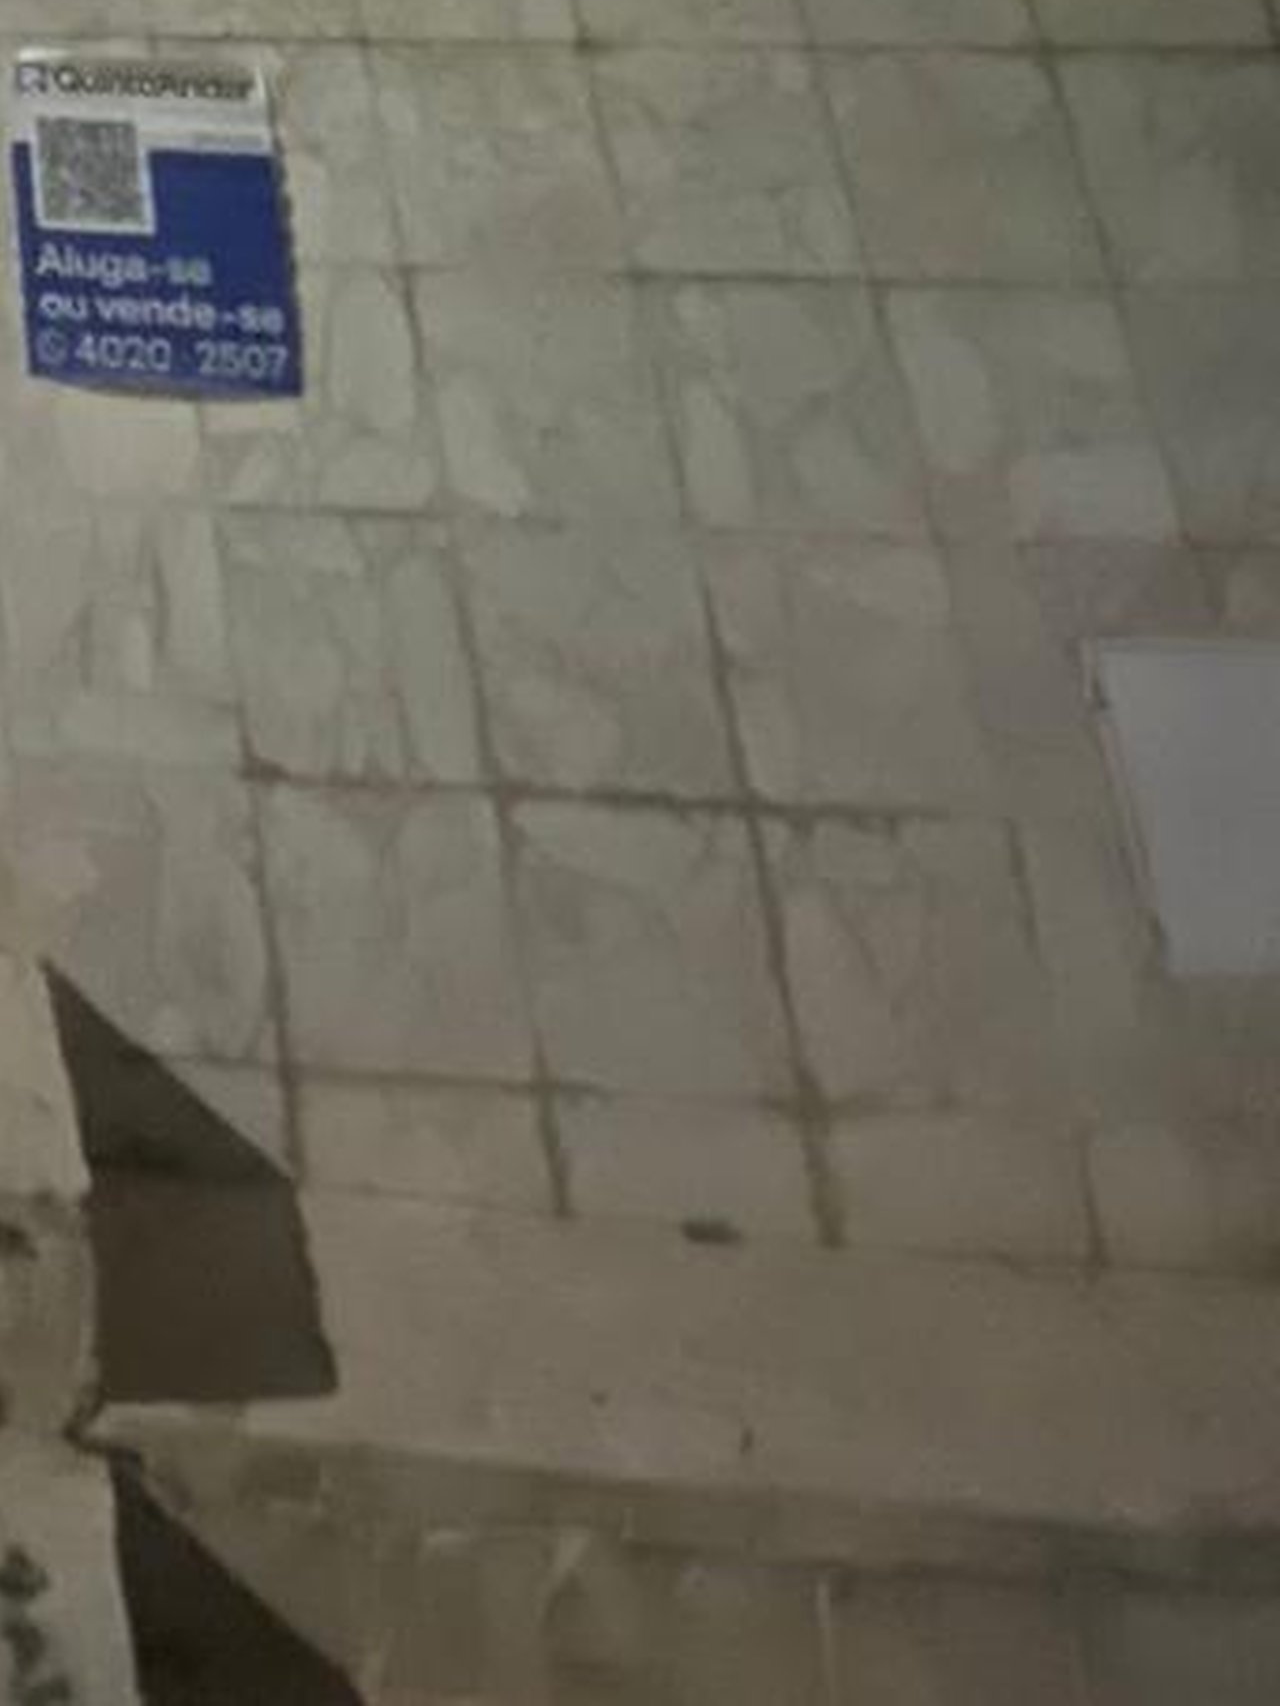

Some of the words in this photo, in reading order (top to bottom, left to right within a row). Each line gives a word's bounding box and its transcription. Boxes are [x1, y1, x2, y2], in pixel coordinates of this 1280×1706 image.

[35, 242, 212, 287] Aluga-se
[38, 293, 87, 321] ou
[94, 292, 285, 334] vende-se
